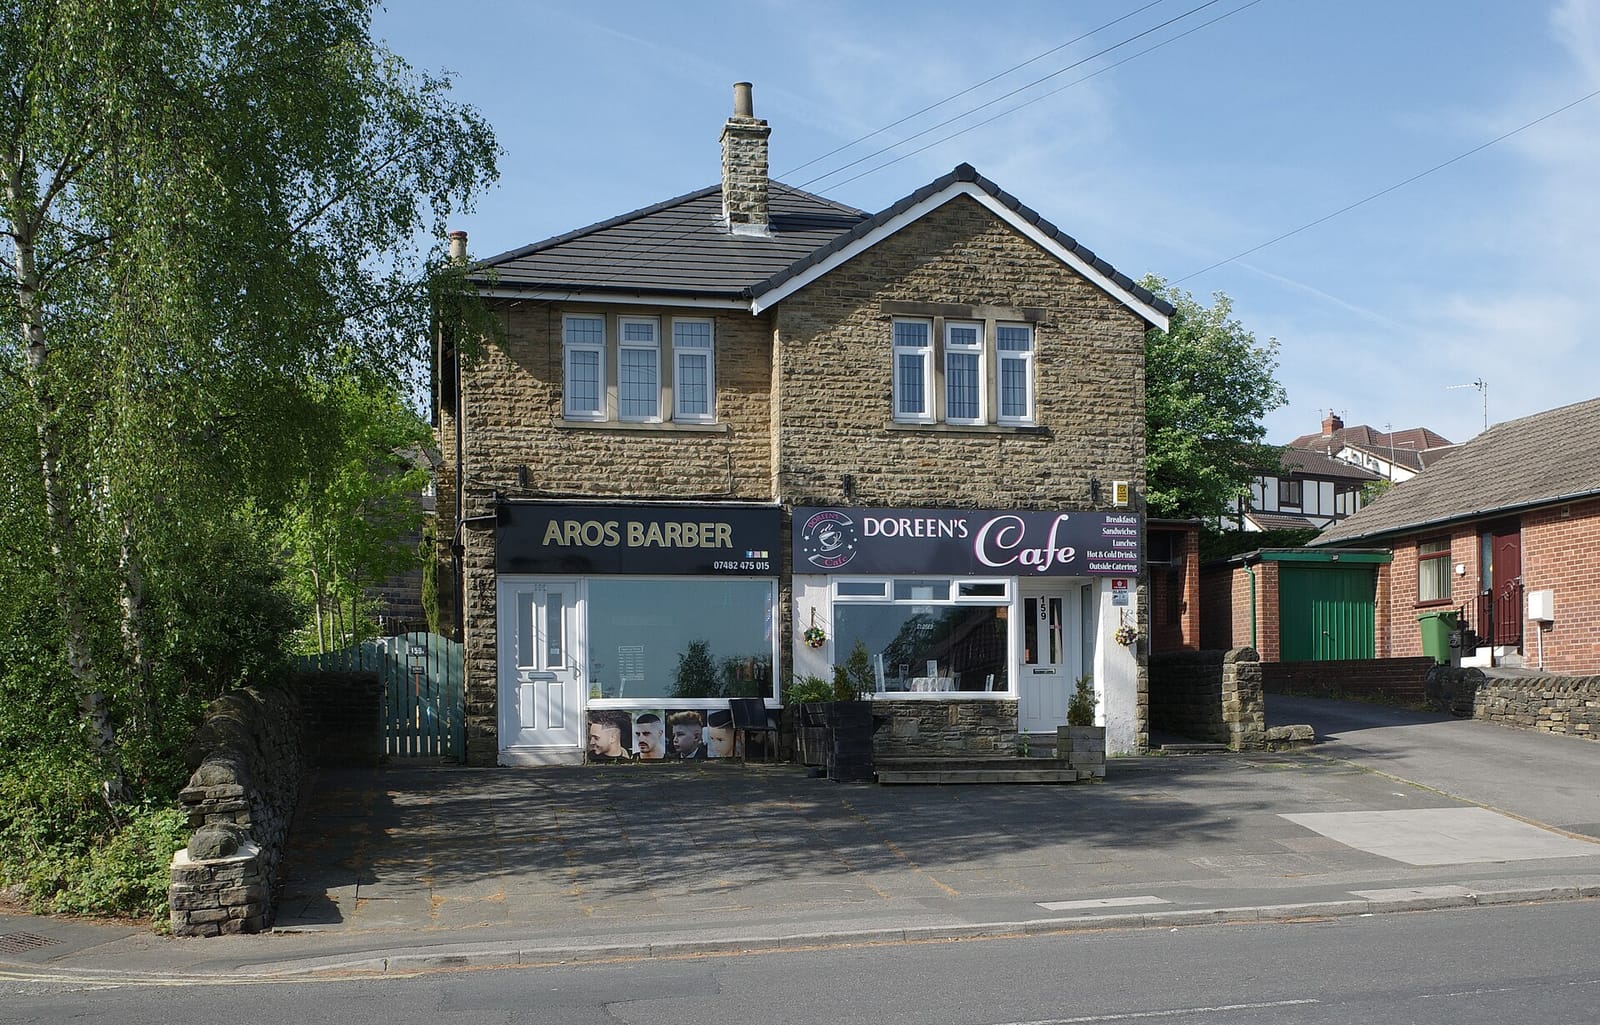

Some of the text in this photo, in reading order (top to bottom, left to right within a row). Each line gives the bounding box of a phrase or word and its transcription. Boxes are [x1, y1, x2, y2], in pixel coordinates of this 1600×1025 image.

[1105, 515, 1137, 524] Breakfasts
[863, 517, 969, 539] DOREEN'S
[1102, 527, 1137, 535] Sandwiches
[542, 519, 733, 548] AROS BARBER
[974, 514, 1076, 572] Cafe
[1112, 539, 1137, 547] Lunches
[1087, 550, 1098, 558] Hot
[1104, 551, 1117, 559] Cold
[1117, 551, 1137, 559] Drinks
[713, 560, 770, 570] 07482 475 015
[1089, 562, 1138, 573] Outside Catering
